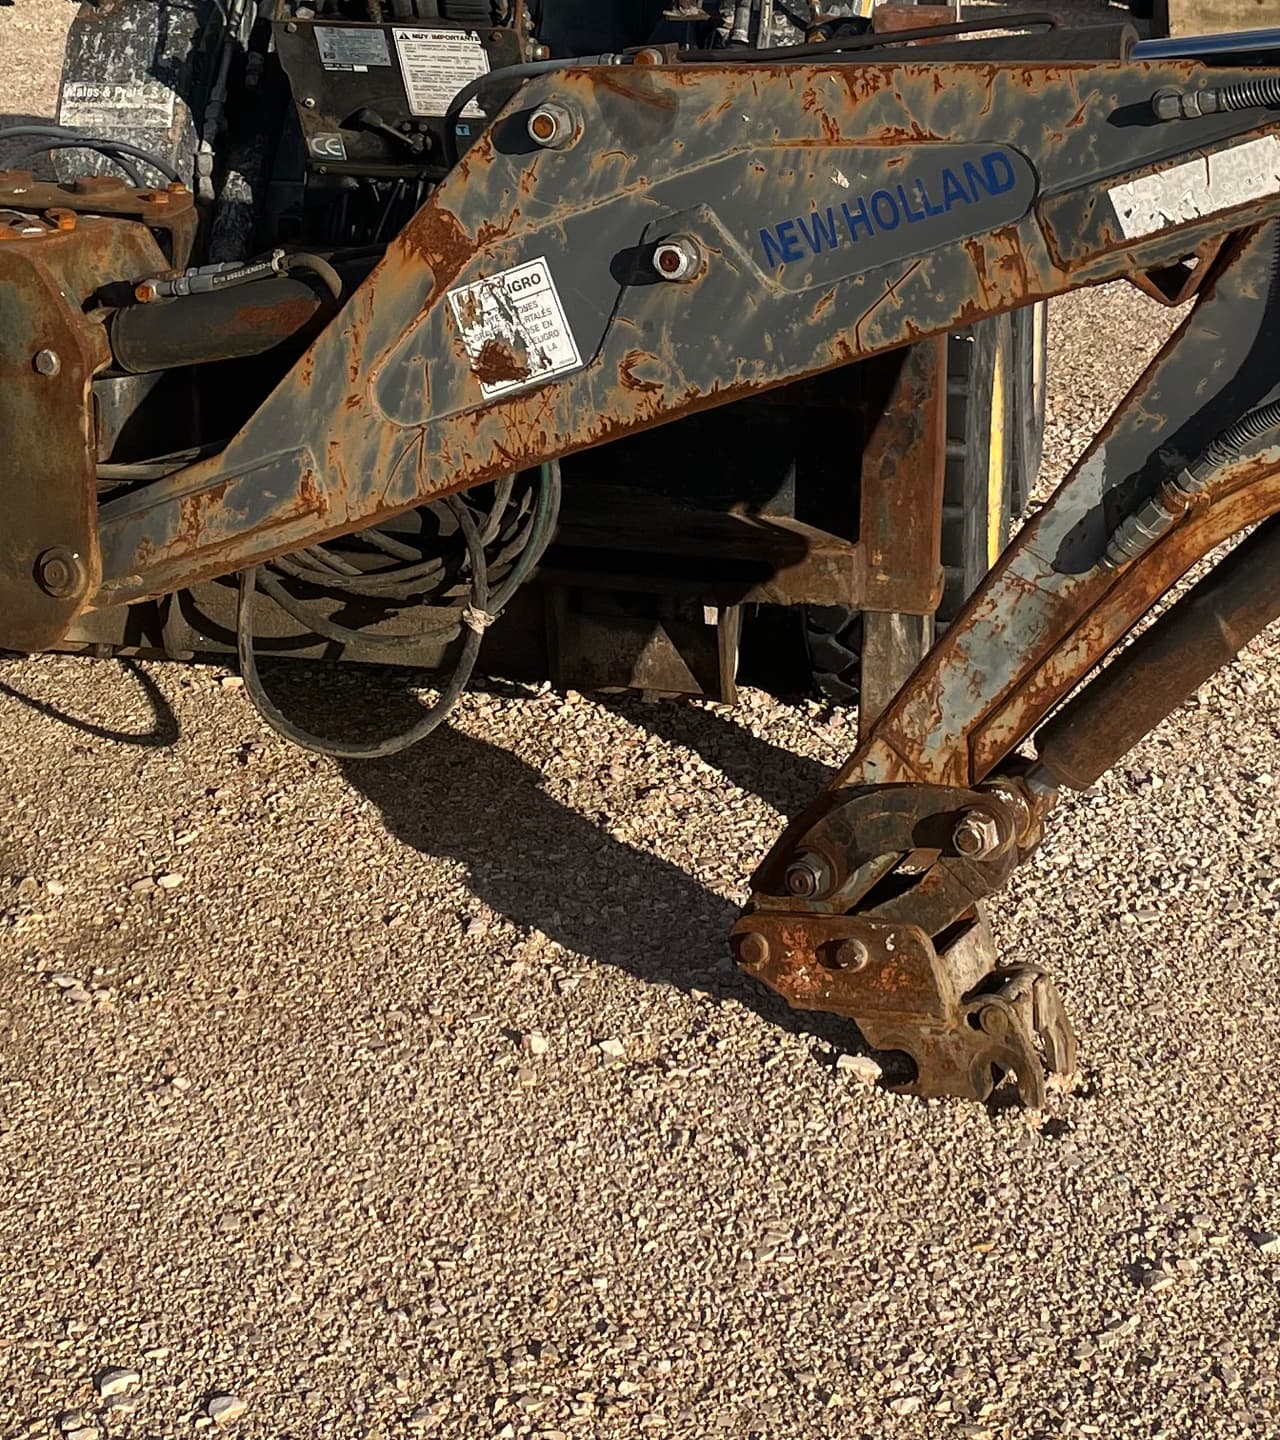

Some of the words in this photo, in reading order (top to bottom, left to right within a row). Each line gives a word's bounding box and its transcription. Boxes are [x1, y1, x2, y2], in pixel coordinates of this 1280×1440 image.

[311, 137, 342, 156] CE
[759, 207, 838, 268] NEW
[840, 151, 1016, 242] HOLLAND
